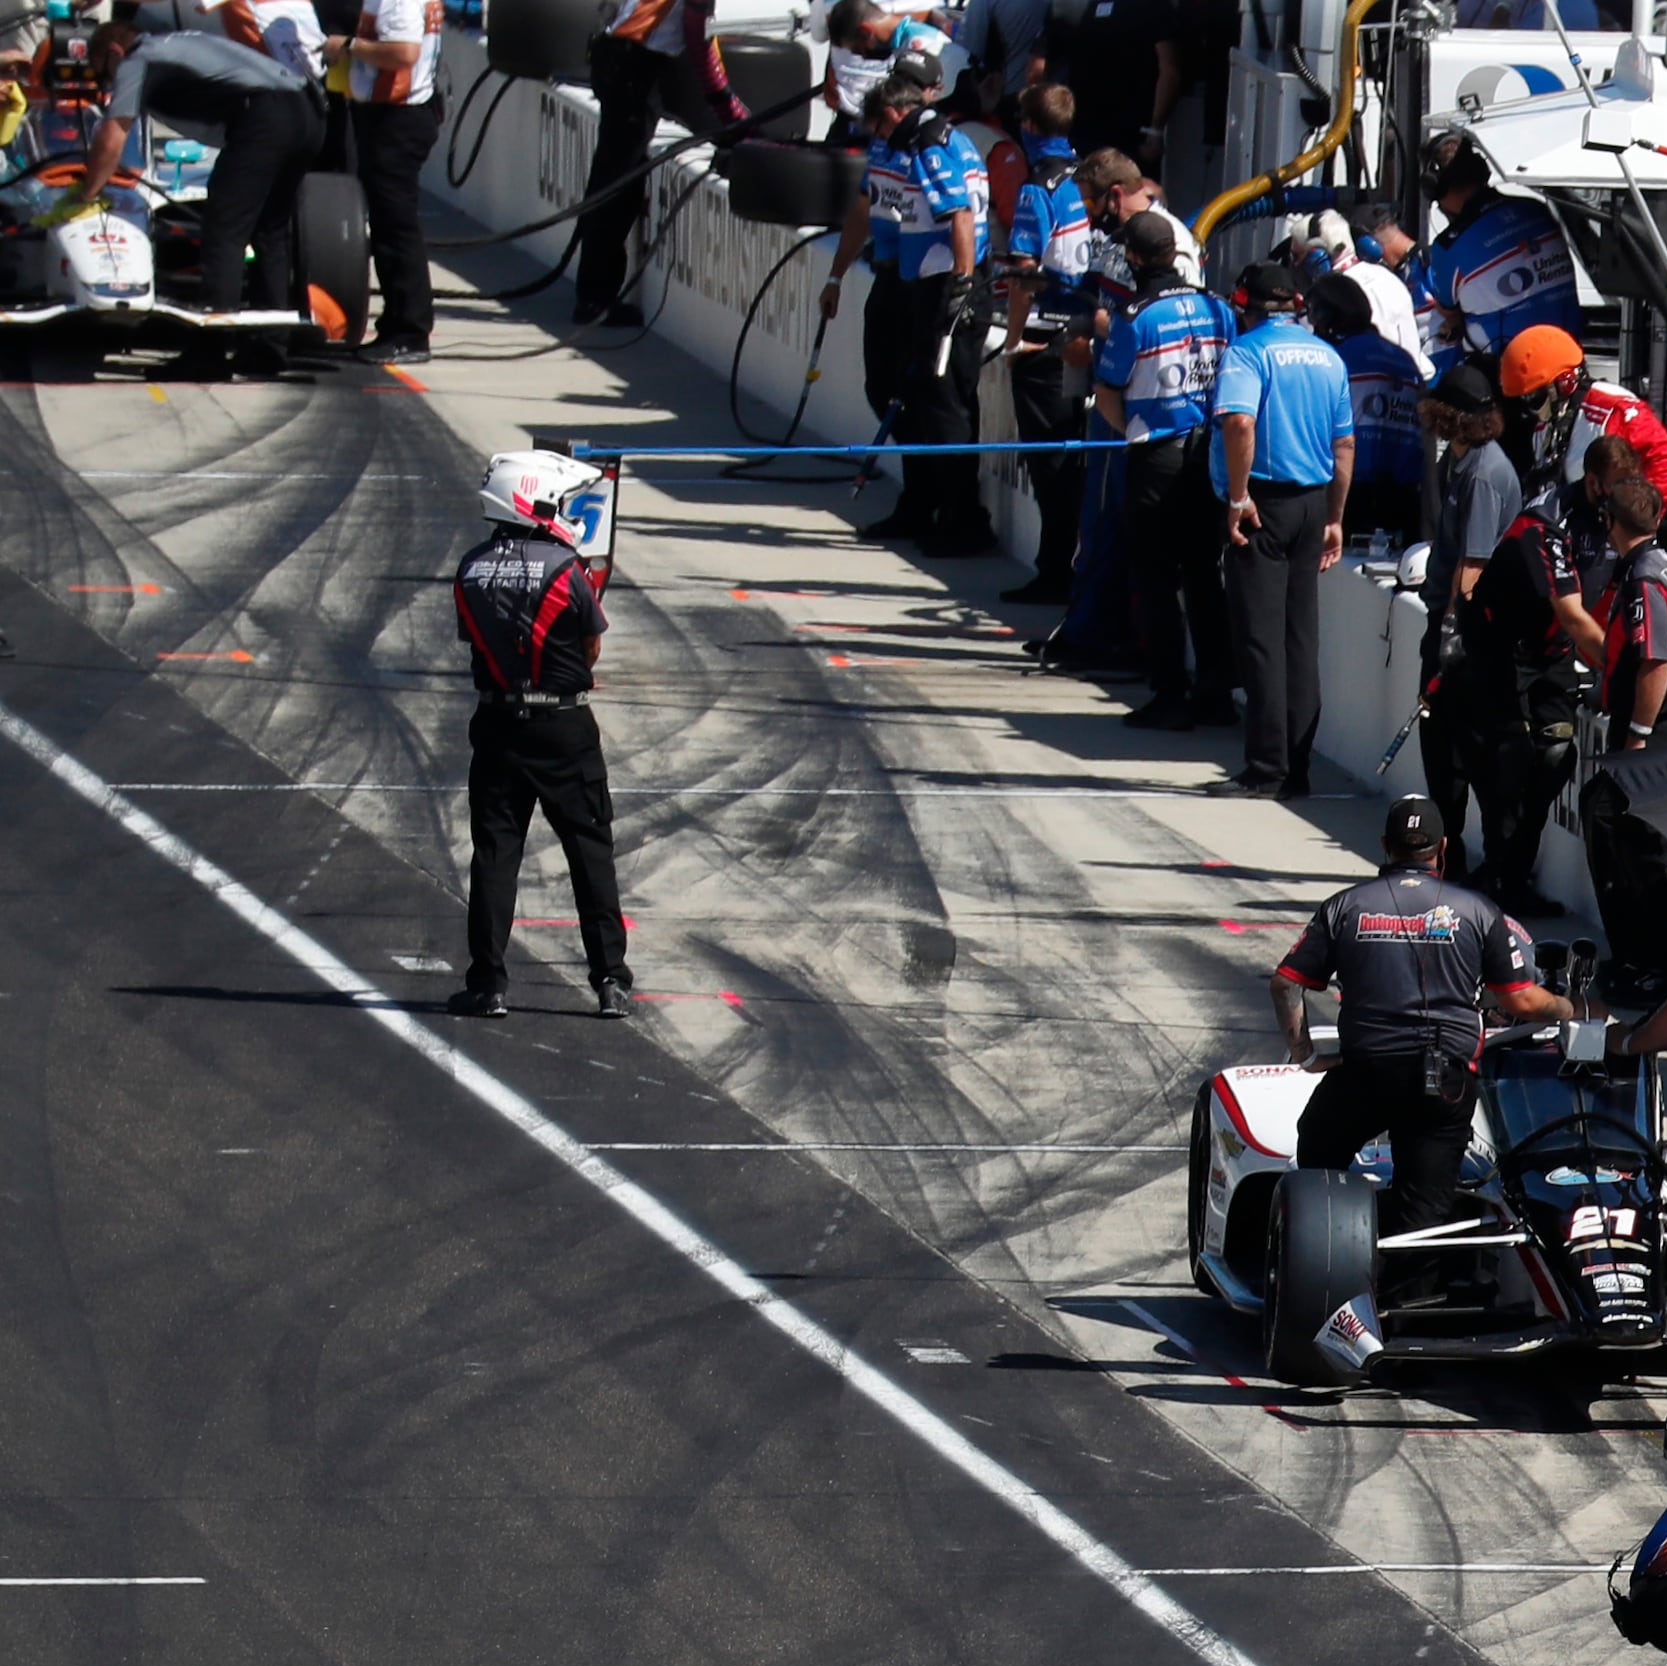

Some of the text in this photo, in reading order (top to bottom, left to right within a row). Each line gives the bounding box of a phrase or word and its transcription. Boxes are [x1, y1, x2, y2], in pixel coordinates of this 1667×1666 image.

[1275, 348, 1332, 368] OFFICIAL
[1407, 815, 1421, 829] 21
[1569, 1205, 1637, 1240] 21
